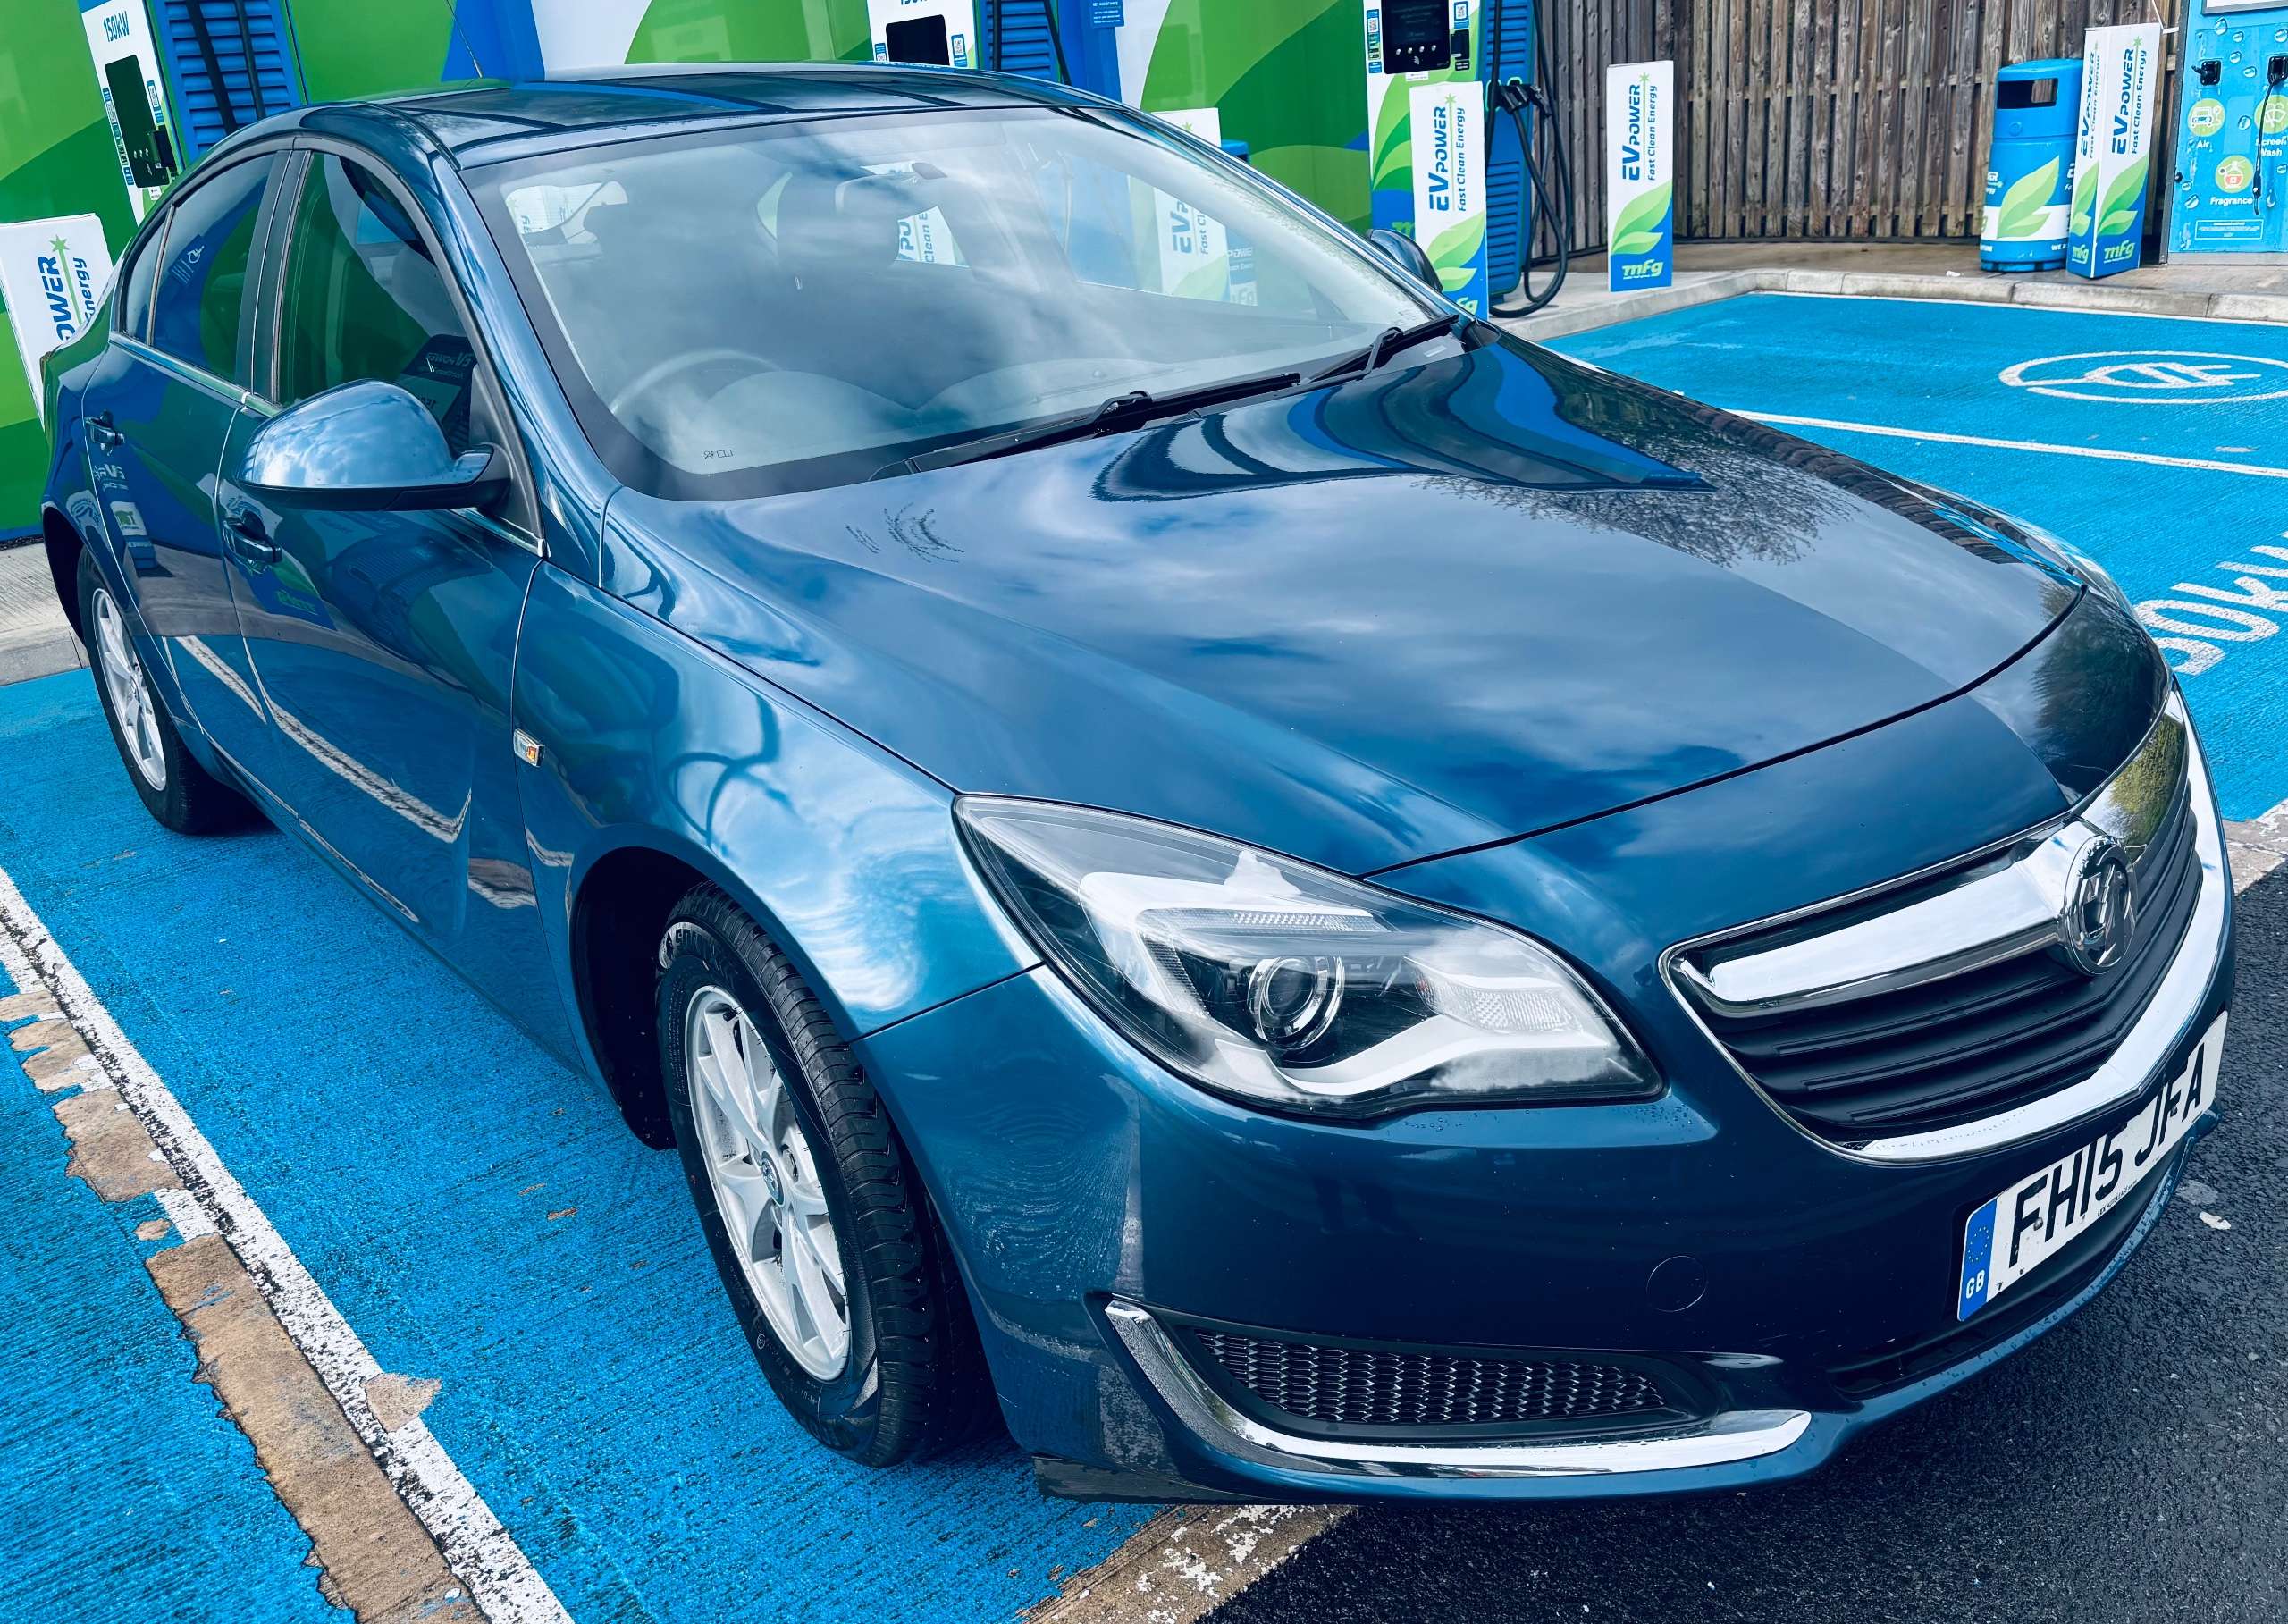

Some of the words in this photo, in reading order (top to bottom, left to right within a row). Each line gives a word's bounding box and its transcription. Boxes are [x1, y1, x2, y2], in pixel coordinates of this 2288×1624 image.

[103, 11, 130, 42] 150kW
[2136, 50, 2147, 91] Energy
[1648, 85, 1658, 123] Energy
[2133, 95, 2142, 128] Clean
[1456, 107, 1466, 148] Energy
[1648, 126, 1656, 156] Clean
[2132, 129, 2140, 154] Fast
[2196, 140, 2210, 148] Air
[1457, 152, 1466, 185] Clean
[1648, 159, 1656, 181] Fast
[1458, 188, 1467, 211] Fast
[2210, 197, 2253, 206] Fragrance
[1199, 229, 1208, 255] Fast
[2104, 240, 2136, 262] mfg
[1622, 259, 1663, 277] mfg
[2134, 1042, 2205, 1166] JFA
[1966, 1269, 1986, 1299] GB
